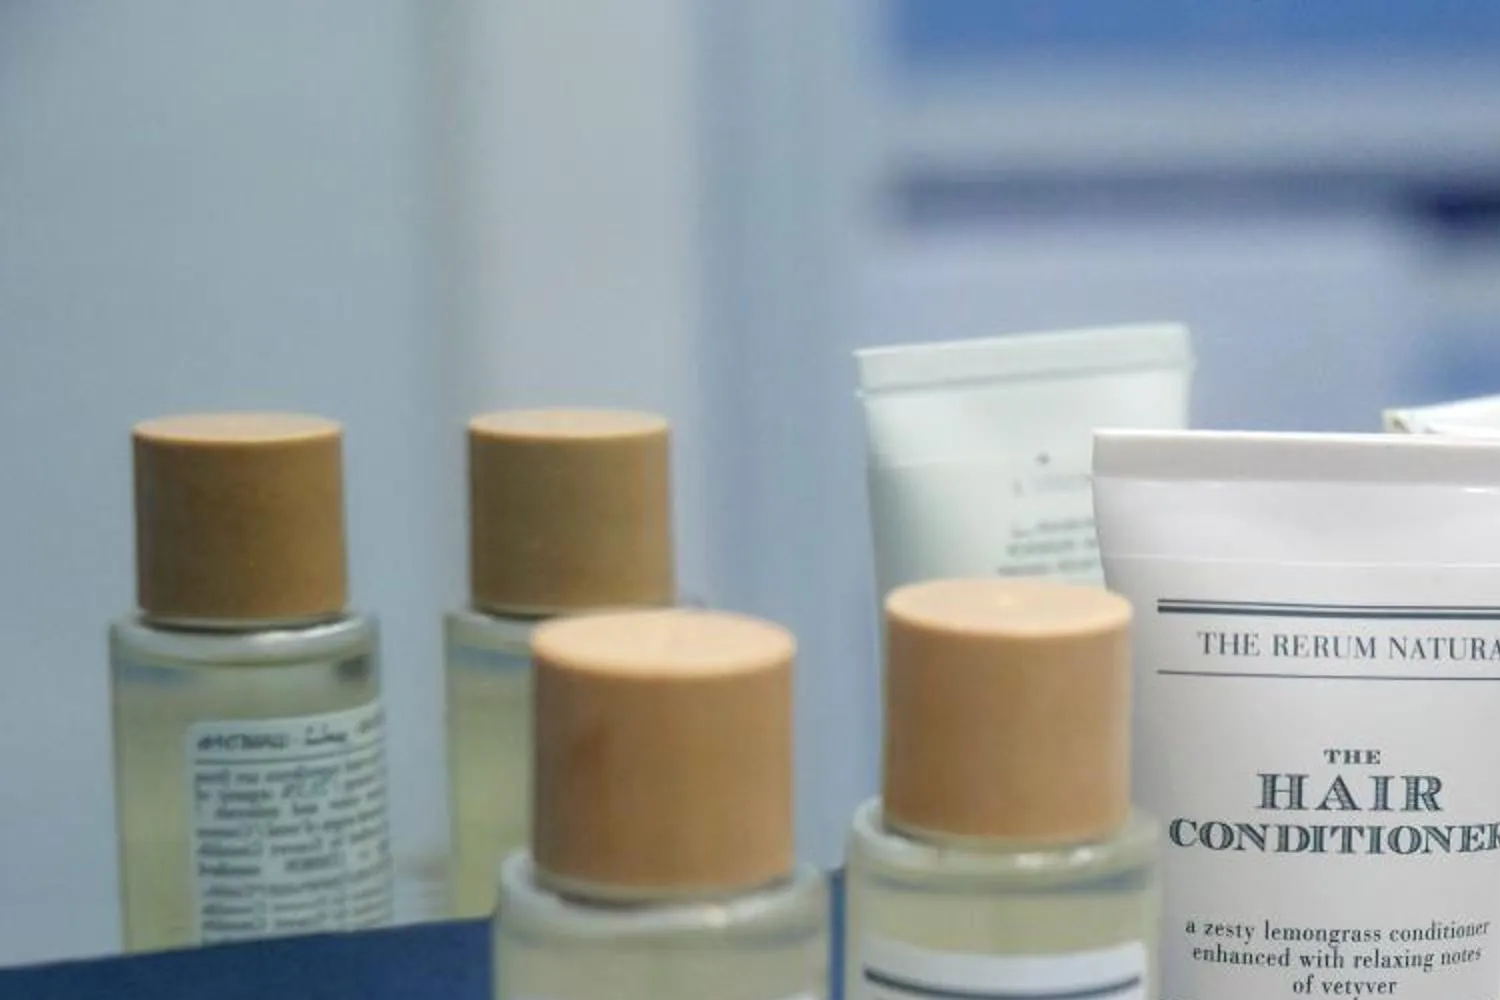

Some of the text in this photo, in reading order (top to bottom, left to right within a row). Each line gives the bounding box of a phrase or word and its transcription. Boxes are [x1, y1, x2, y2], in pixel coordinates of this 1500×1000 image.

[1197, 631, 1261, 657] THE
[1272, 634, 1377, 660] RERUM
[1323, 748, 1381, 765] THE
[1255, 772, 1443, 812] HAIR
[1185, 919, 1491, 946] a zesty lemongrass conditioner
[1192, 946, 1482, 973] enhanced with relaxing notes
[1292, 975, 1400, 1000] of vetyver
